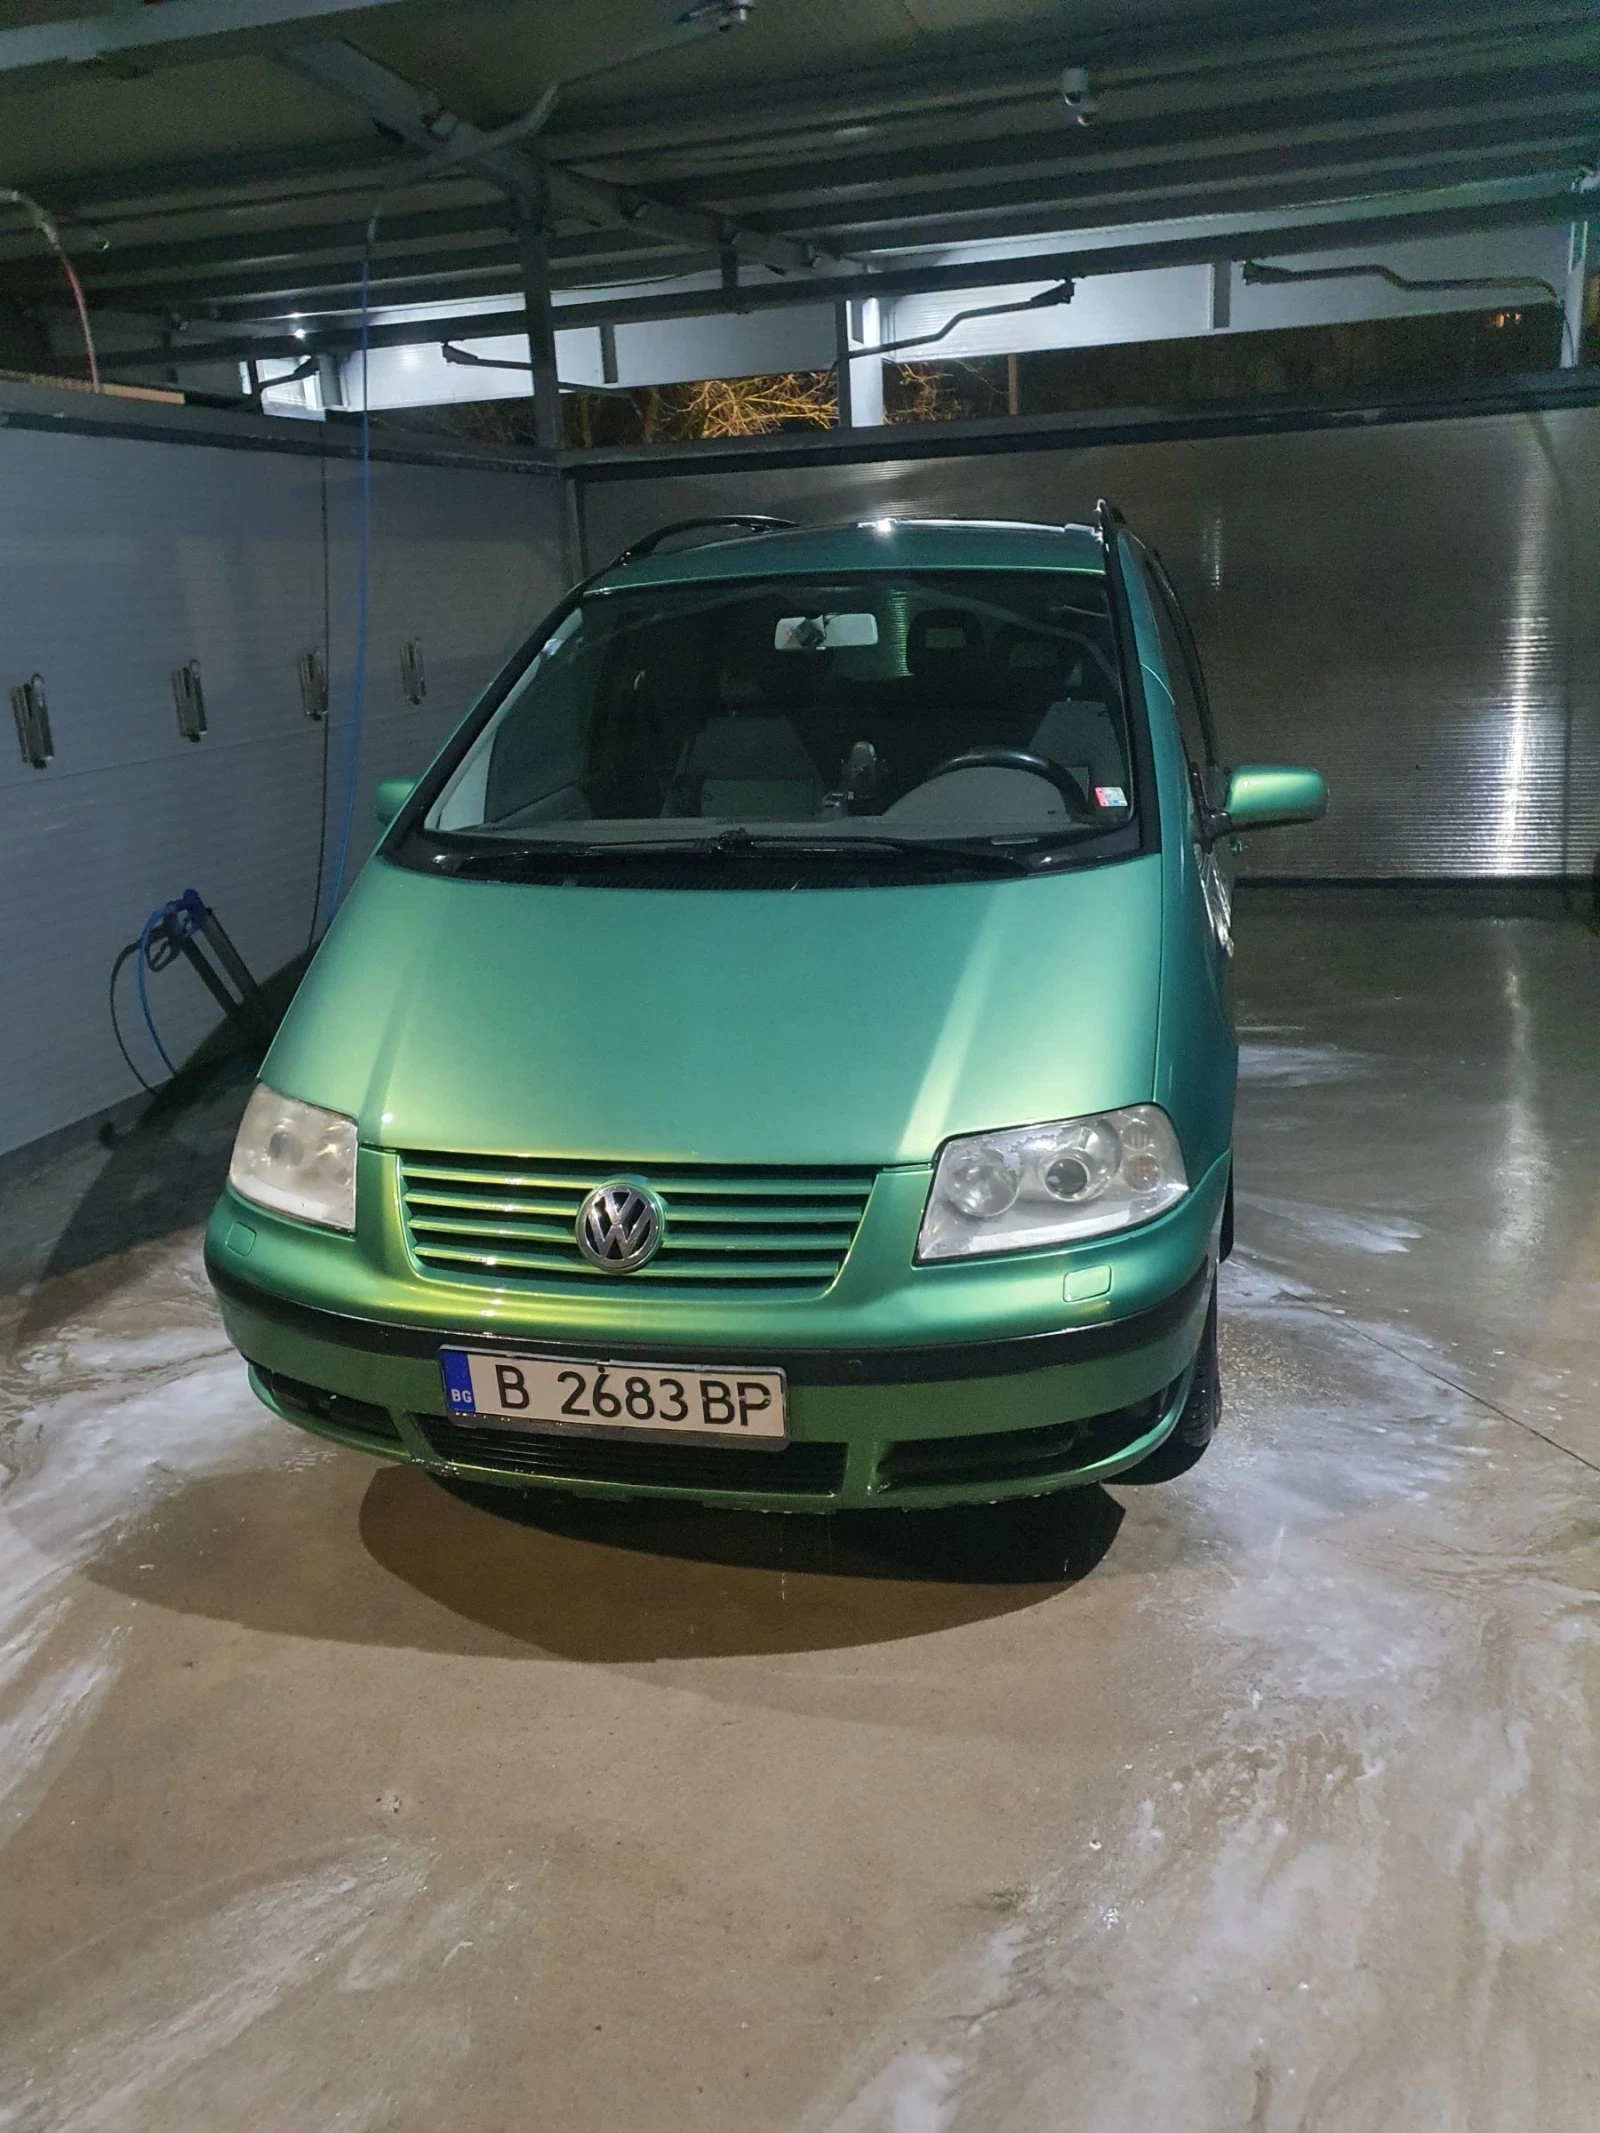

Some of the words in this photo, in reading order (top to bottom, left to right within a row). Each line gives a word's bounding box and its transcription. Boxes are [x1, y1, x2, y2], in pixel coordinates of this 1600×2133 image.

[580, 1185, 658, 1267] VW
[451, 1388, 473, 1404] BG
[495, 1364, 530, 1410] B
[557, 1371, 689, 1422] 2683
[699, 1379, 772, 1427] BP
